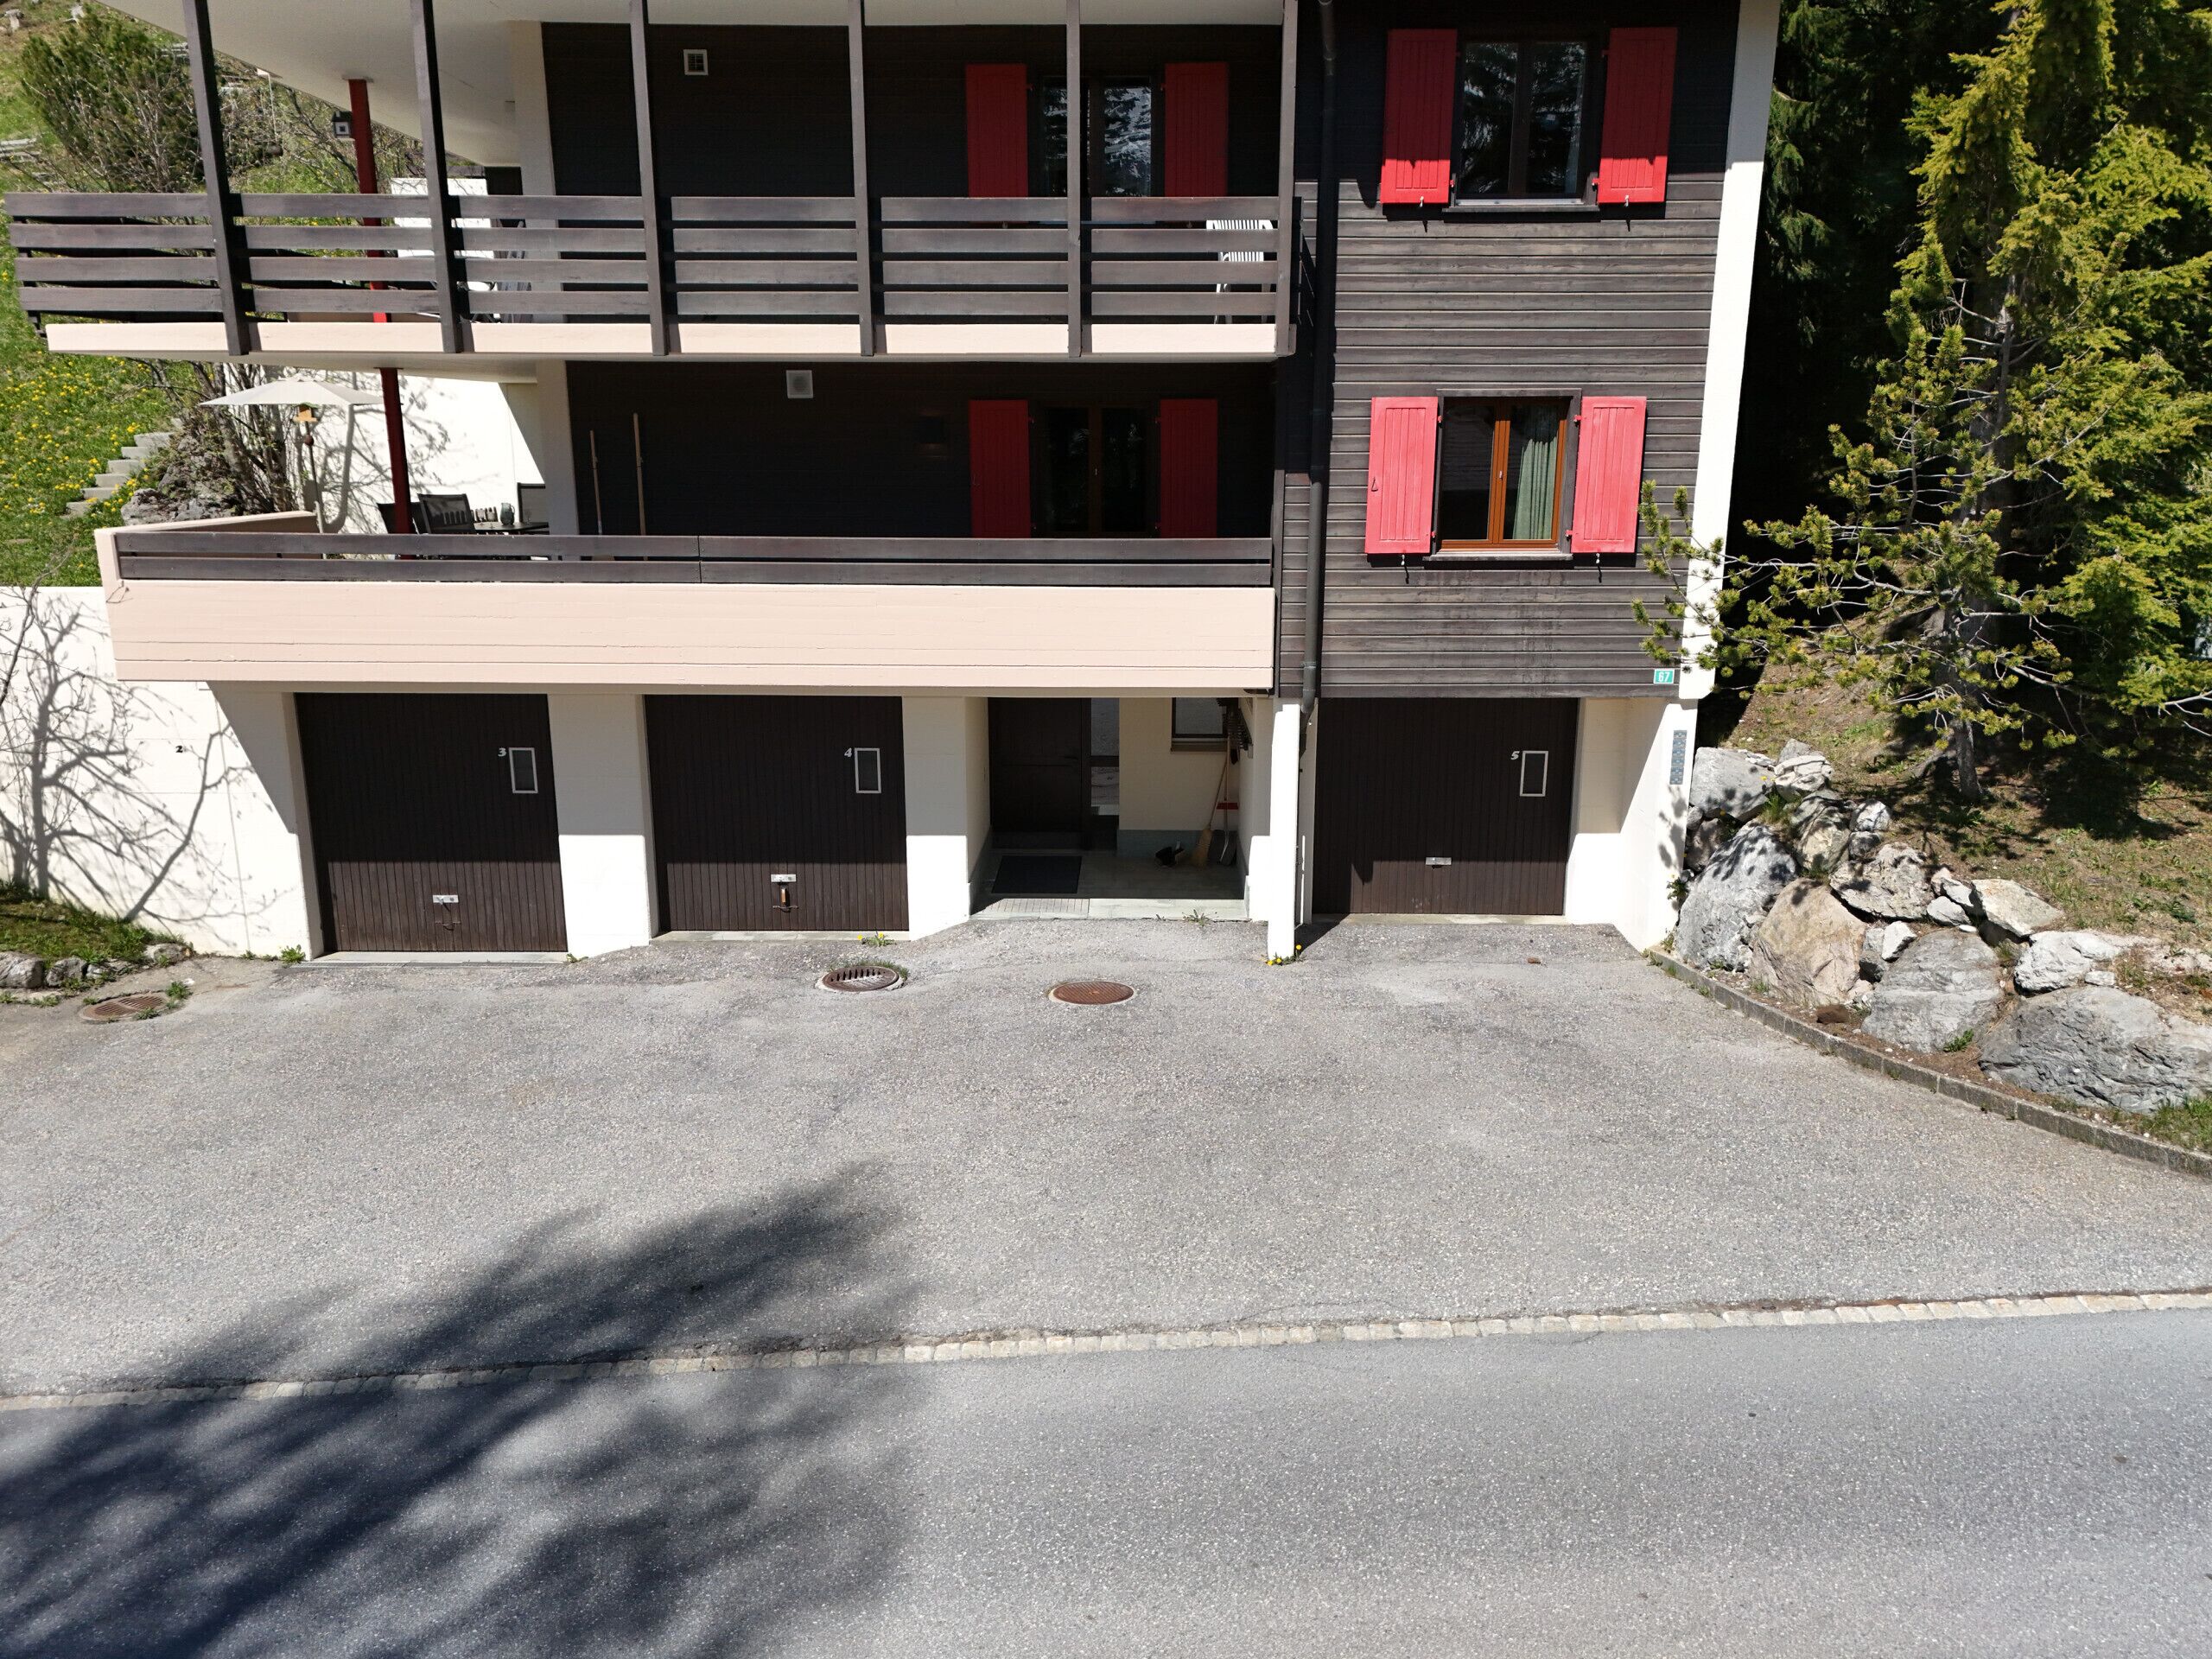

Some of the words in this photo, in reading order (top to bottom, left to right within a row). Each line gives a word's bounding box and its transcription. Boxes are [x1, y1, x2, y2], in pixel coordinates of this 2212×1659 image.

[1659, 671, 1669, 683] 67
[498, 747, 506, 757] 3
[843, 747, 852, 757] 4
[1510, 751, 1520, 760] 5
